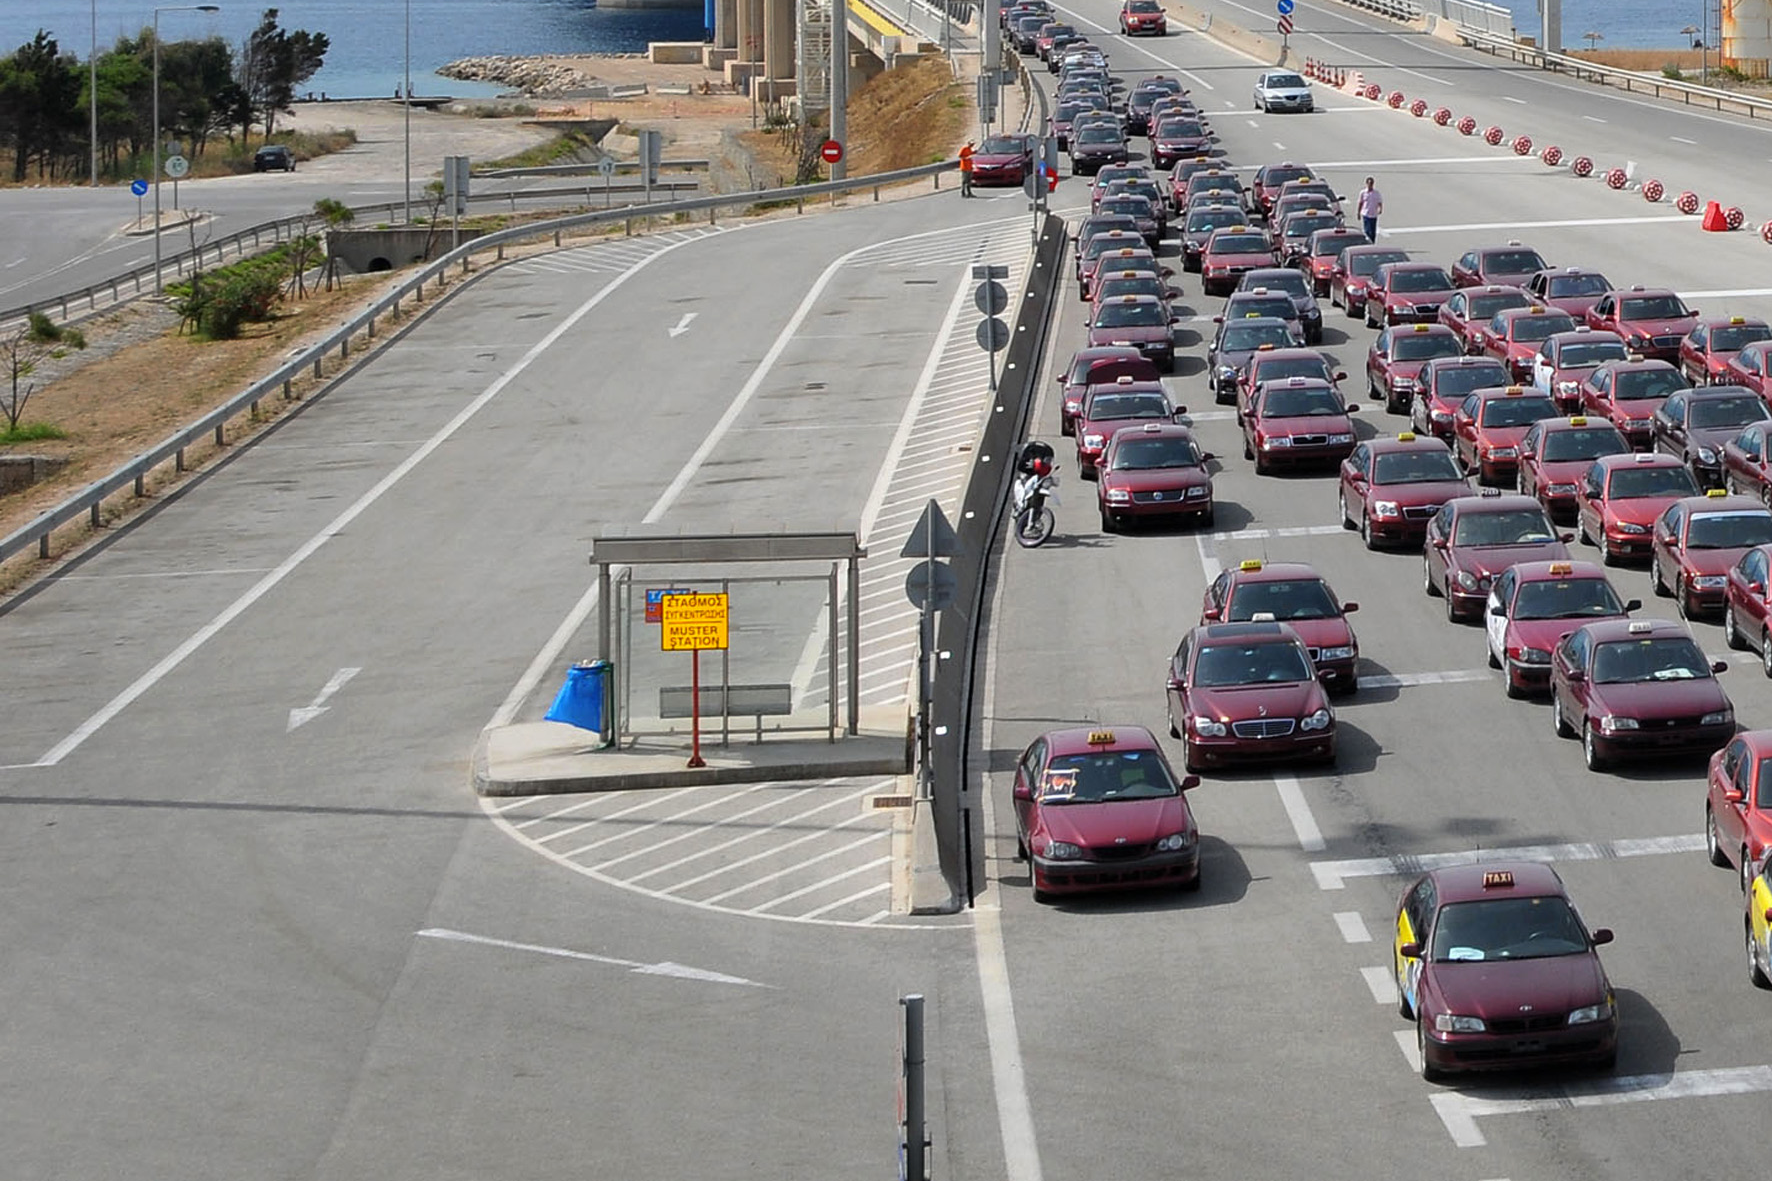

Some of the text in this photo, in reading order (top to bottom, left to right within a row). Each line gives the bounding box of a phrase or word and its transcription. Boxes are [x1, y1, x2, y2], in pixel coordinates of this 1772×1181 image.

[667, 597, 723, 608] ΣΤΑΘΜΟΣ
[670, 626, 718, 636] MUSTER
[670, 636, 720, 647] STATION
[1092, 733, 1112, 741] TAXI
[1488, 872, 1511, 883] TAXI
